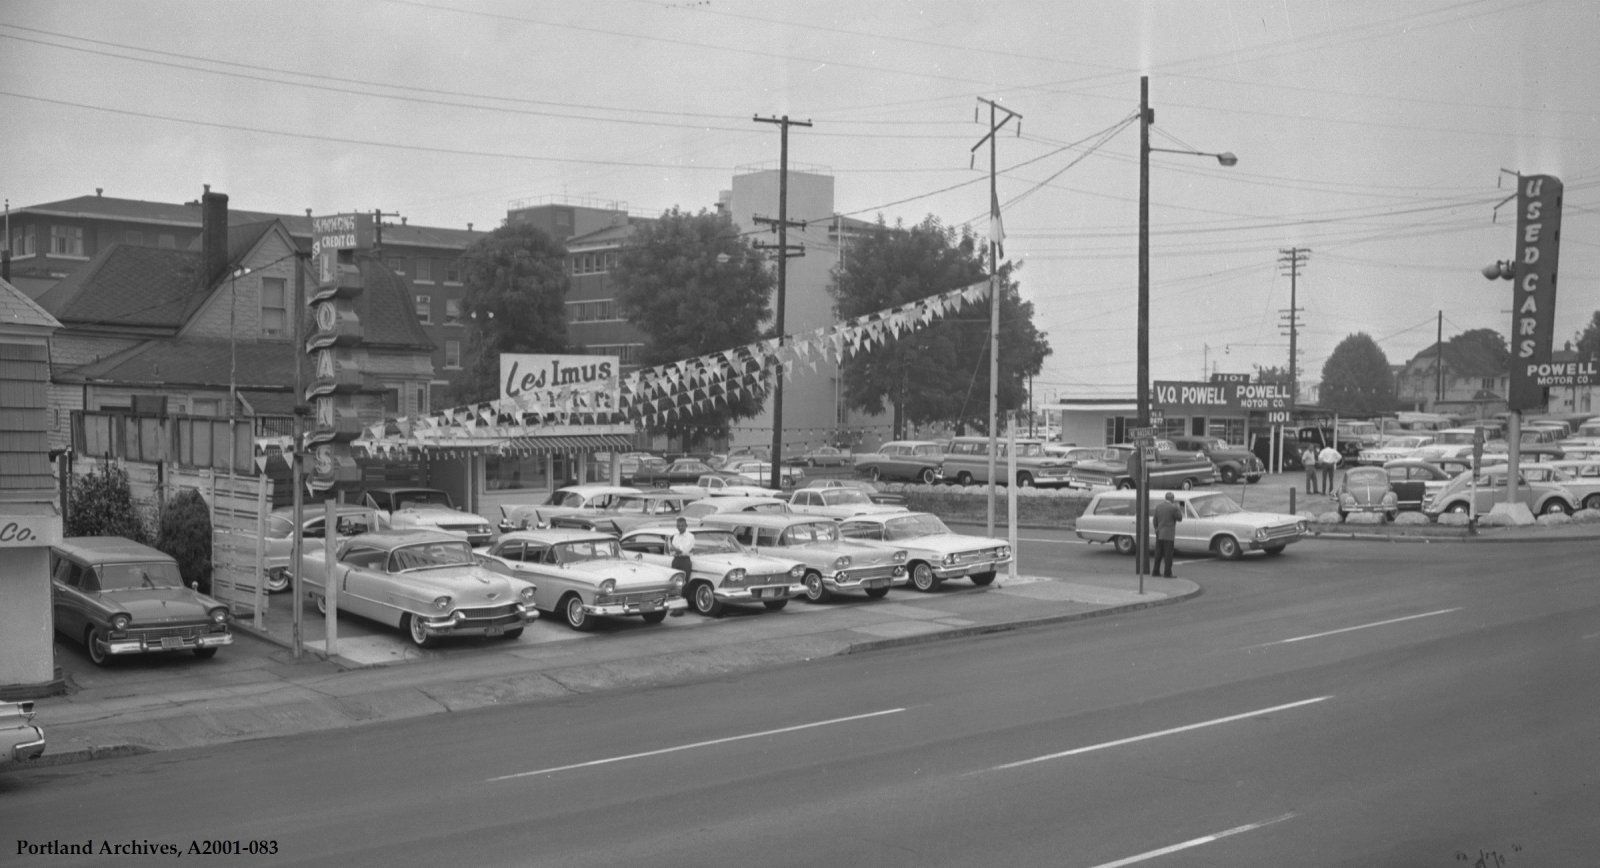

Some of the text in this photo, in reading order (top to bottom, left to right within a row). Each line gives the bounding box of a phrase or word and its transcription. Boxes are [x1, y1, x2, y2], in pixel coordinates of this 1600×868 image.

[322, 233, 357, 248] CREDIT CO.
[1519, 179, 1543, 358] USED CARS
[316, 256, 336, 474] LOANS
[1527, 362, 1597, 376] POWELL
[505, 360, 611, 398] Les Imus
[1537, 376, 1593, 386] MOTOR CO.
[1156, 386, 1228, 405] V.O. POWELL
[1236, 385, 1291, 399] POWELL
[1240, 399, 1286, 408] MOTOR CO.
[1268, 411, 1290, 423] 1101
[0, 522, 37, 542] Co.
